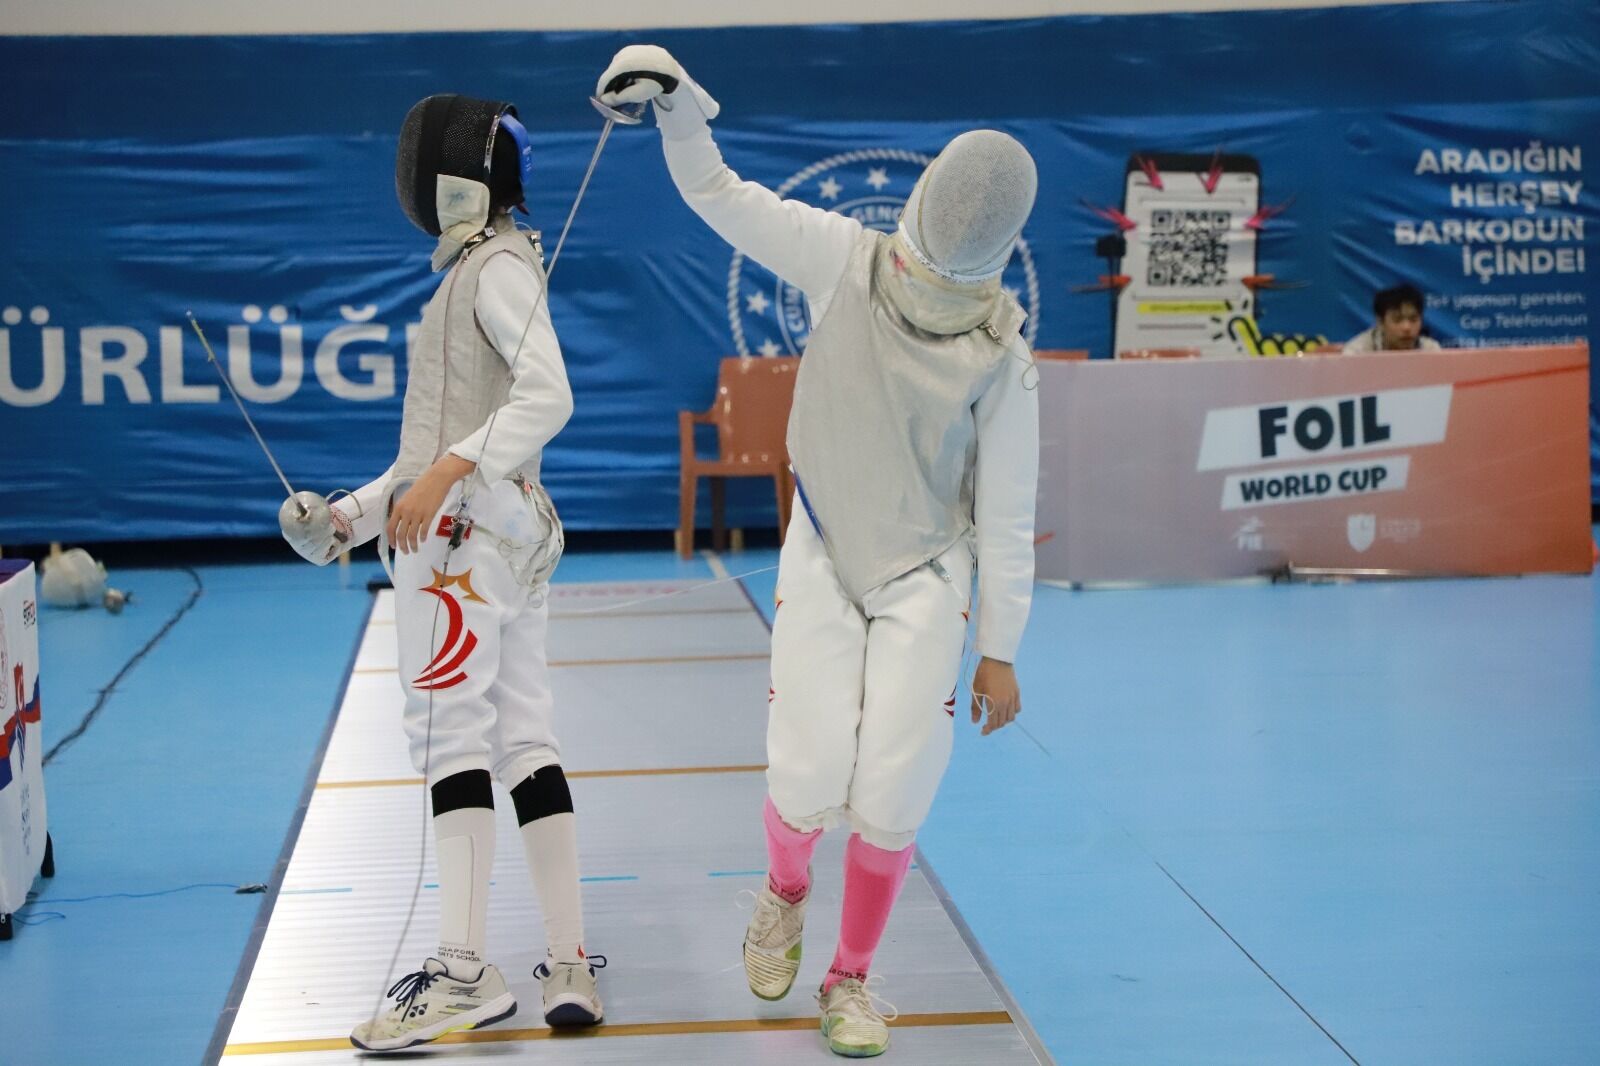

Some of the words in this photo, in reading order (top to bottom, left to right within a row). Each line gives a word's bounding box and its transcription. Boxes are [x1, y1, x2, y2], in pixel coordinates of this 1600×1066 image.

[1415, 140, 1582, 175] ARADIĞIN
[1450, 180, 1583, 214] HERŞEY
[1394, 218, 1584, 246] BARKODUN
[1259, 395, 1391, 458] FOIL
[1240, 473, 1331, 502] WORLD
[1338, 466, 1388, 492] CUP
